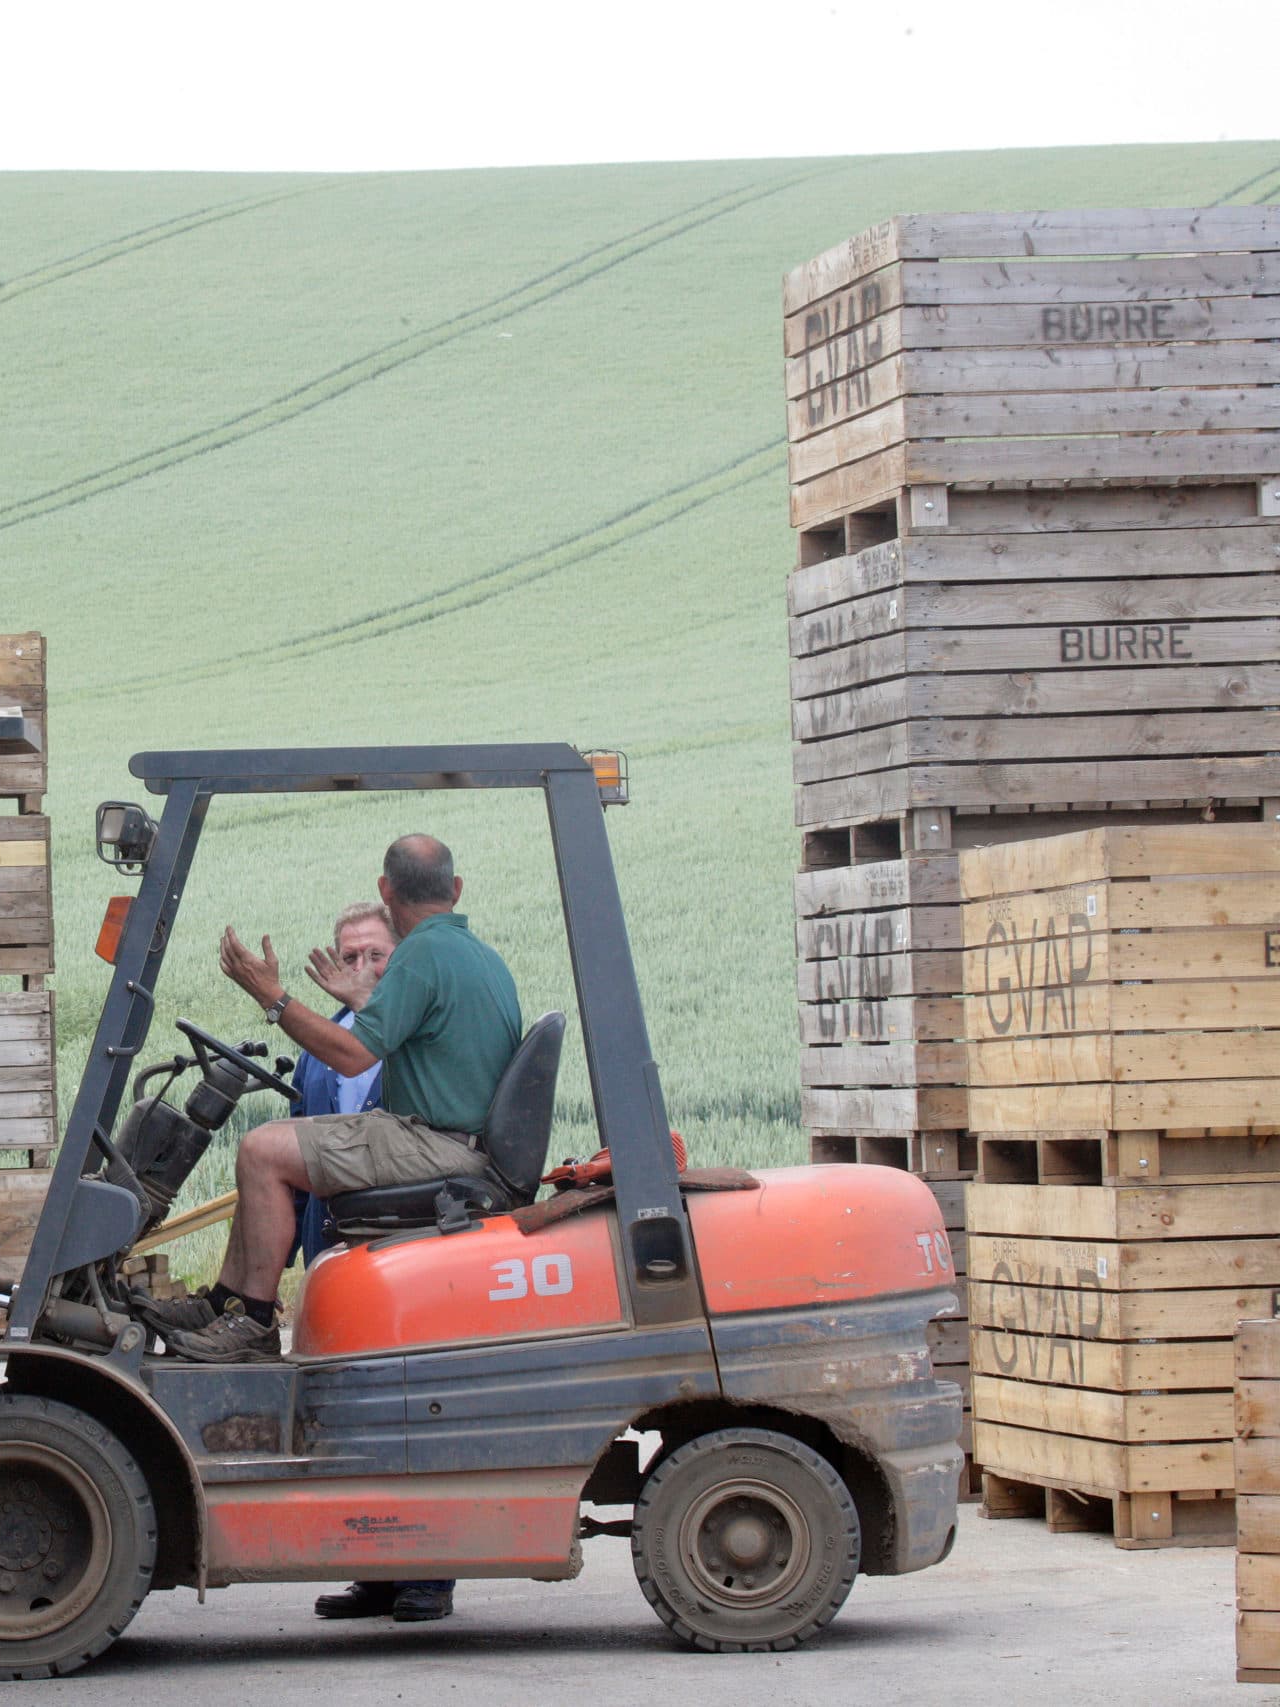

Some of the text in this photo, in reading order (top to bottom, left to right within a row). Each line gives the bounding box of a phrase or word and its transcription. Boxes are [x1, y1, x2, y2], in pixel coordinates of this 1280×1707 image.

[1041, 304, 1175, 342] BURRE
[1060, 624, 1193, 663] BURRE
[815, 917, 894, 1039] GVAP
[984, 912, 1093, 1035] GVAP
[488, 1253, 574, 1302] 30
[989, 1261, 1104, 1385] GVAP
